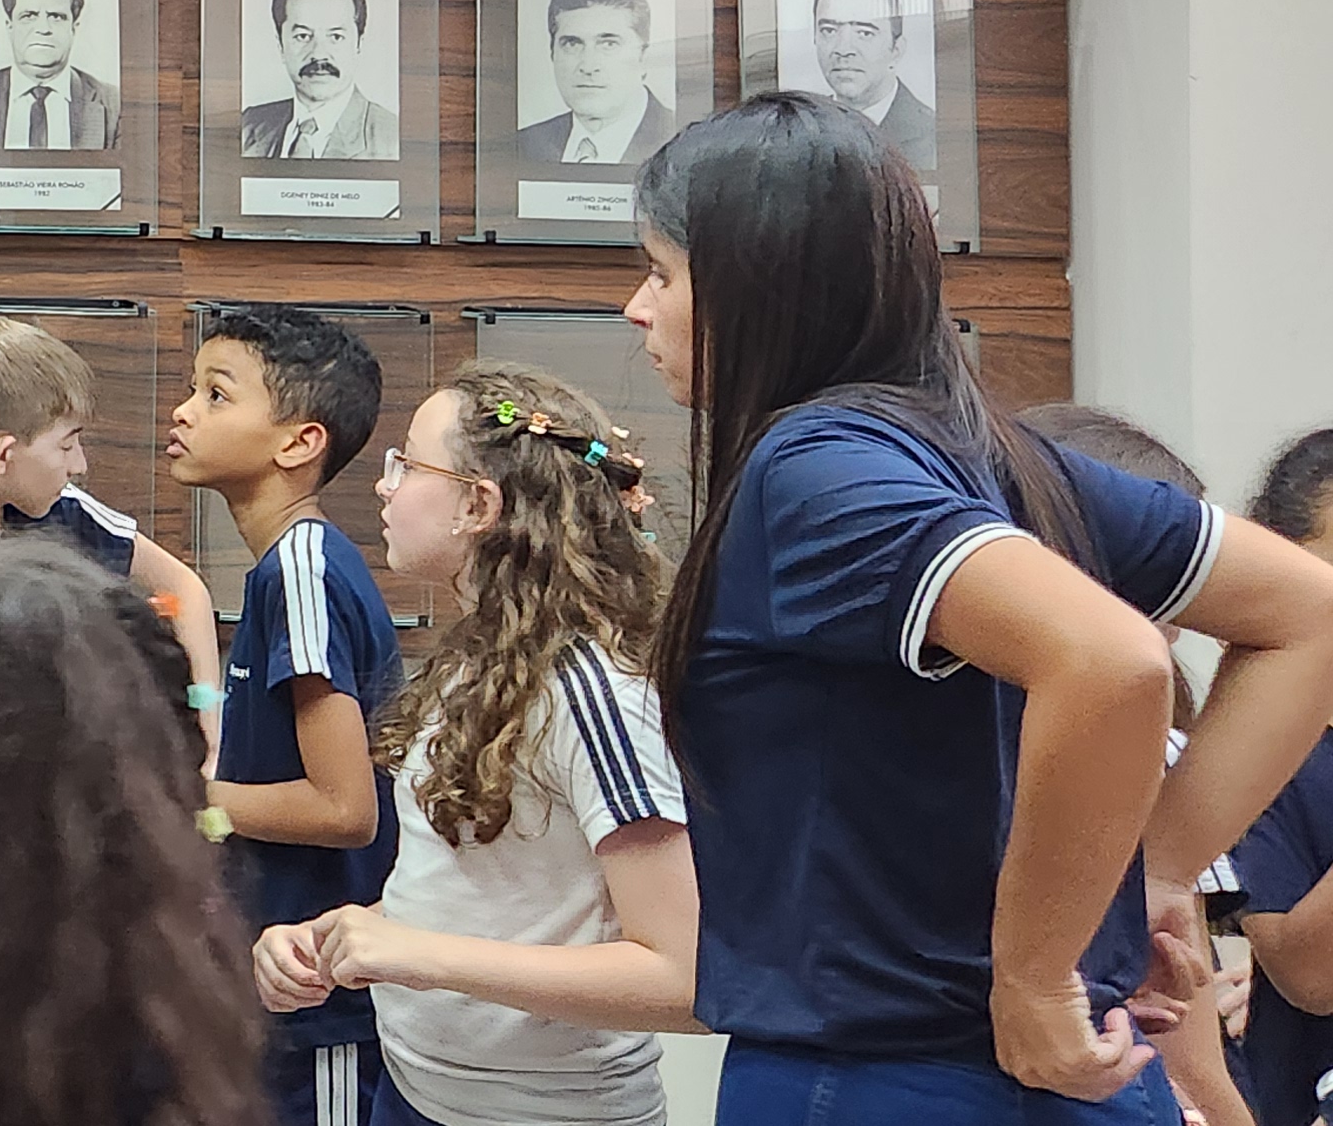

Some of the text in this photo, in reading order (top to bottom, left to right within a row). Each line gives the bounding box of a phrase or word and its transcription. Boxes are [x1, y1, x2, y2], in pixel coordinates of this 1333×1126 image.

[0, 180, 86, 189] SEBASTIÃO VIEIRA ROMÃO
[310, 192, 330, 200] DINIZ
